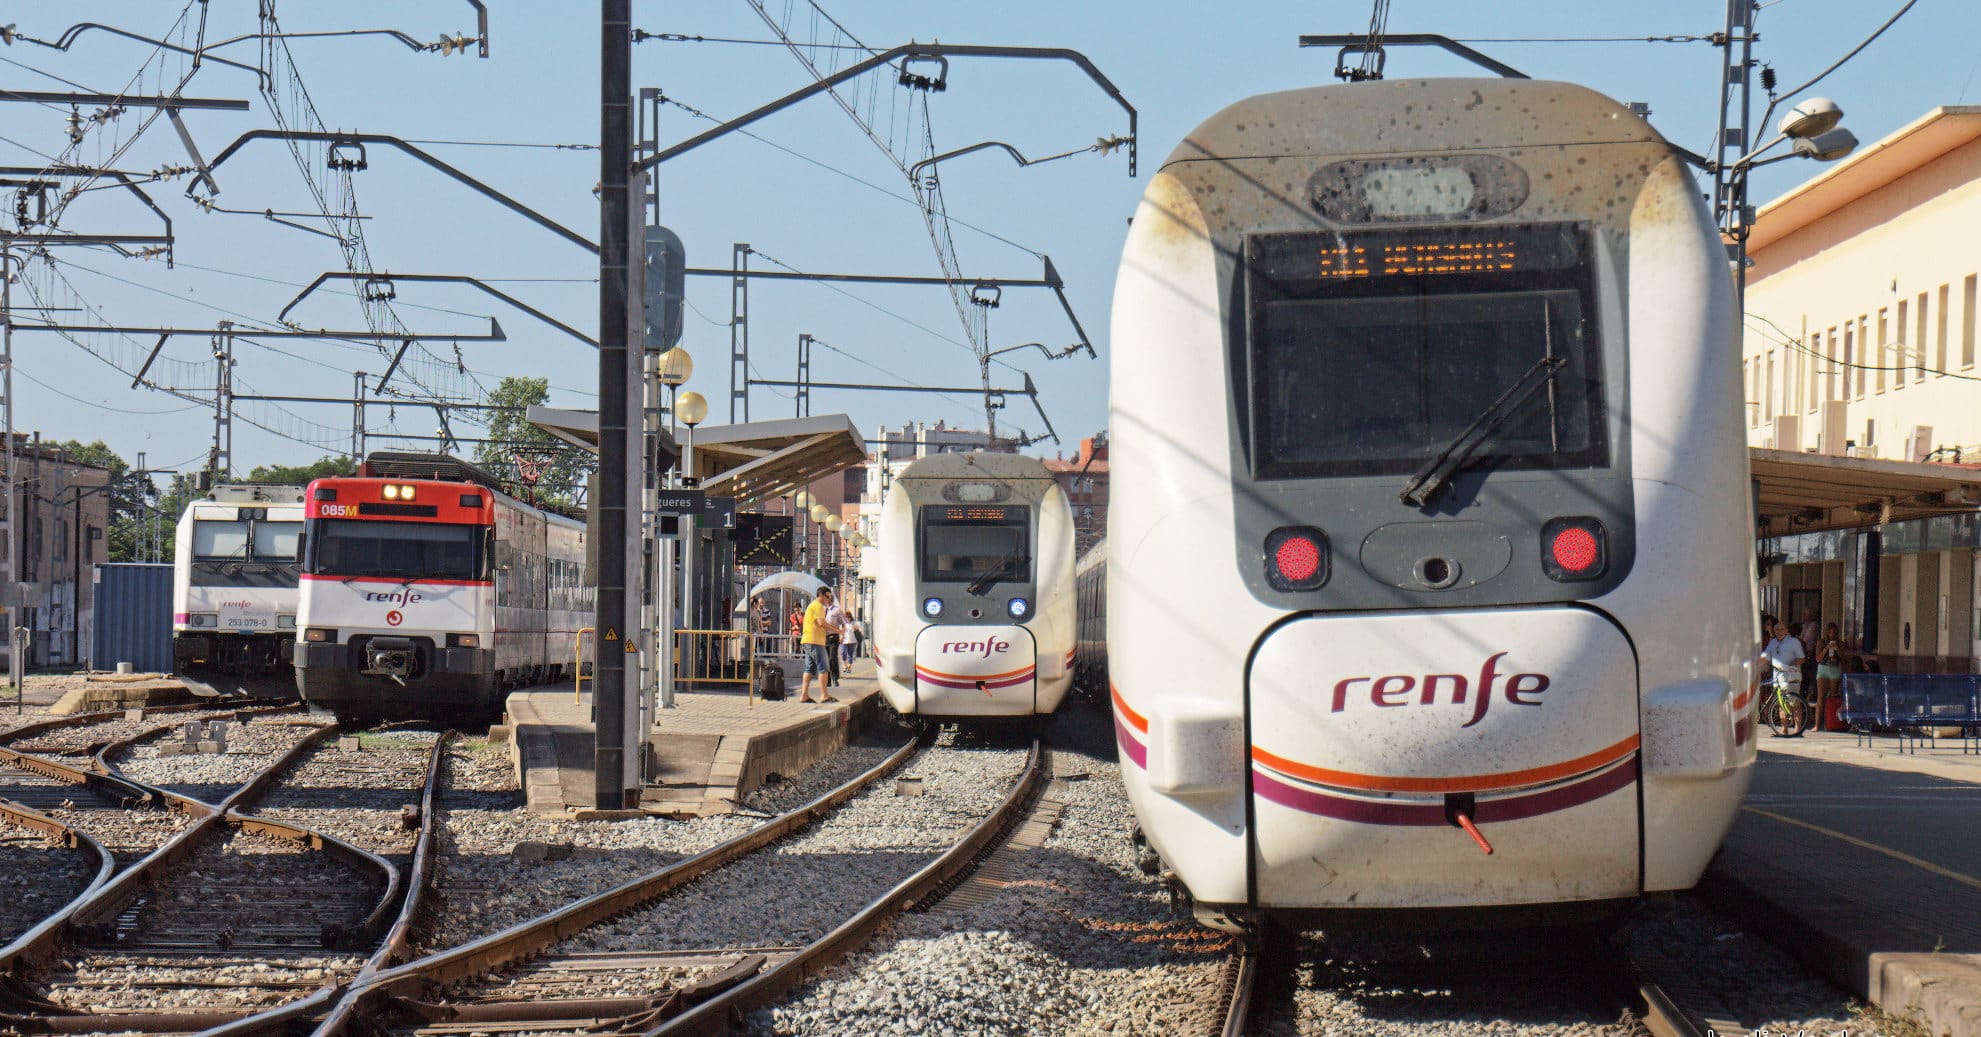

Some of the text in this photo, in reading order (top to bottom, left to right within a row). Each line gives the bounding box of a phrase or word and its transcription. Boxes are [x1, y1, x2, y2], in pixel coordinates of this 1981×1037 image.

[321, 504, 358, 517] 085M
[723, 511, 733, 528] 1
[753, 526, 761, 540] 1
[832, 577, 839, 587] 1
[366, 588, 422, 609] renfe
[942, 635, 1010, 659] renfe
[1331, 651, 1551, 728] renfe
